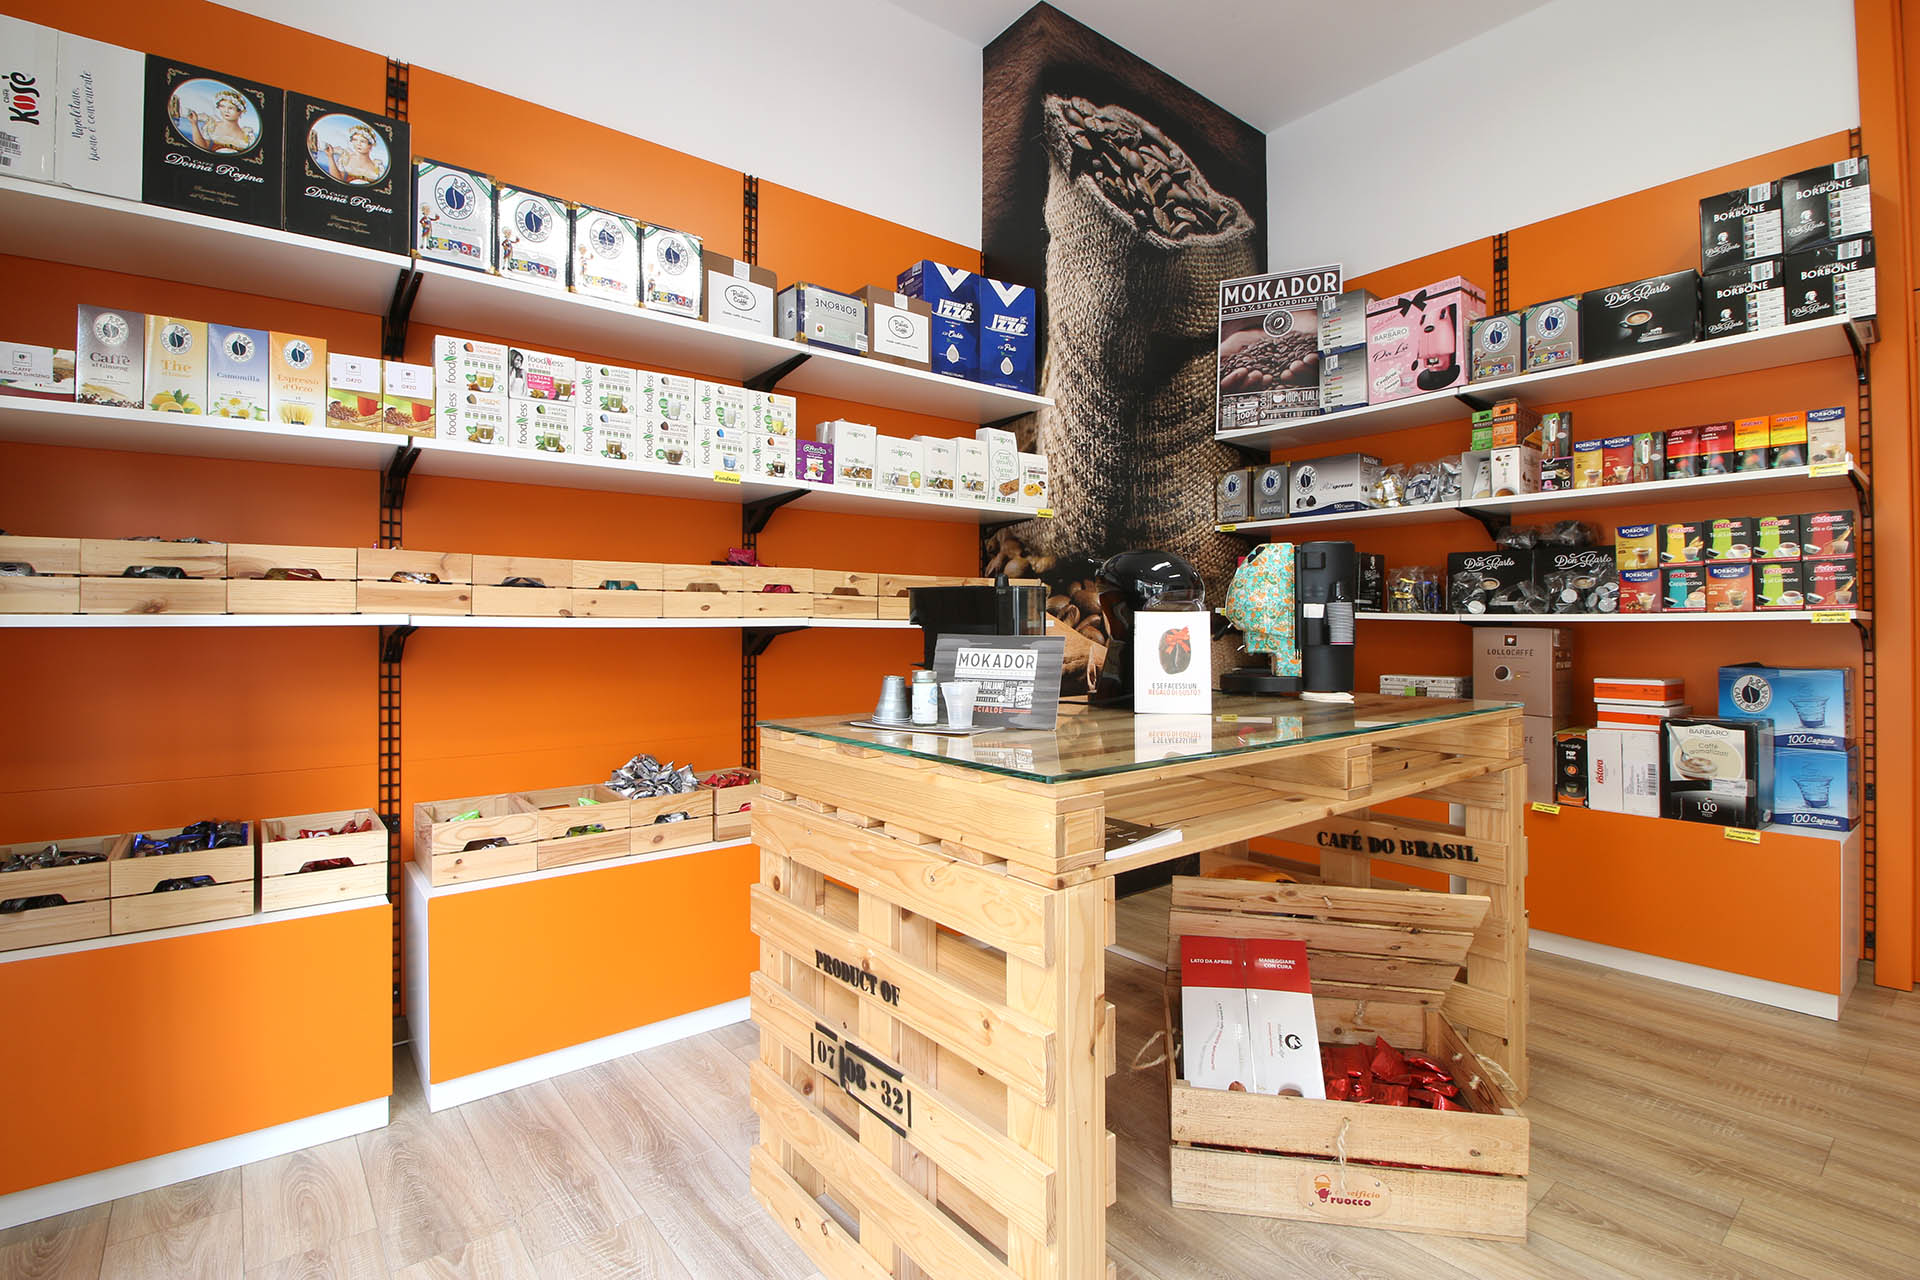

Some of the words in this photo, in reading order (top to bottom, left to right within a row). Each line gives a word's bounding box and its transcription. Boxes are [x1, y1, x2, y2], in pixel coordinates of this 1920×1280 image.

[164, 152, 213, 173] Donna
[216, 164, 265, 184] Regina
[1795, 178, 1853, 200] BORBONE
[304, 186, 348, 205] Donna
[351, 195, 393, 215] Regina
[1713, 203, 1766, 223] BORBONE
[1800, 260, 1858, 280] BORBONE
[1224, 271, 1337, 306] MOKADOR
[1716, 280, 1769, 299] BORBONE
[1230, 304, 1255, 314] 100%
[1464, 558, 1484, 570] Don
[1554, 554, 1578, 568] Don
[1713, 566, 1745, 575] BORBONE
[957, 652, 1035, 669] MOKADOR
[1688, 728, 1729, 737] BARBARO
[1788, 734, 1806, 744] 100
[1806, 735, 1835, 745] Capsule
[1696, 801, 1718, 813] 100
[1791, 813, 1810, 824] 100
[1810, 815, 1839, 826] Capsule
[1316, 829, 1363, 851] CAFÉ
[1367, 836, 1396, 854] DO
[1400, 839, 1479, 862] BRASIL
[1258, 957, 1296, 965] MANEGGIARE
[814, 948, 878, 996] PRODUCT
[880, 979, 901, 1007] OF
[1330, 1197, 1372, 1207] ruocco
